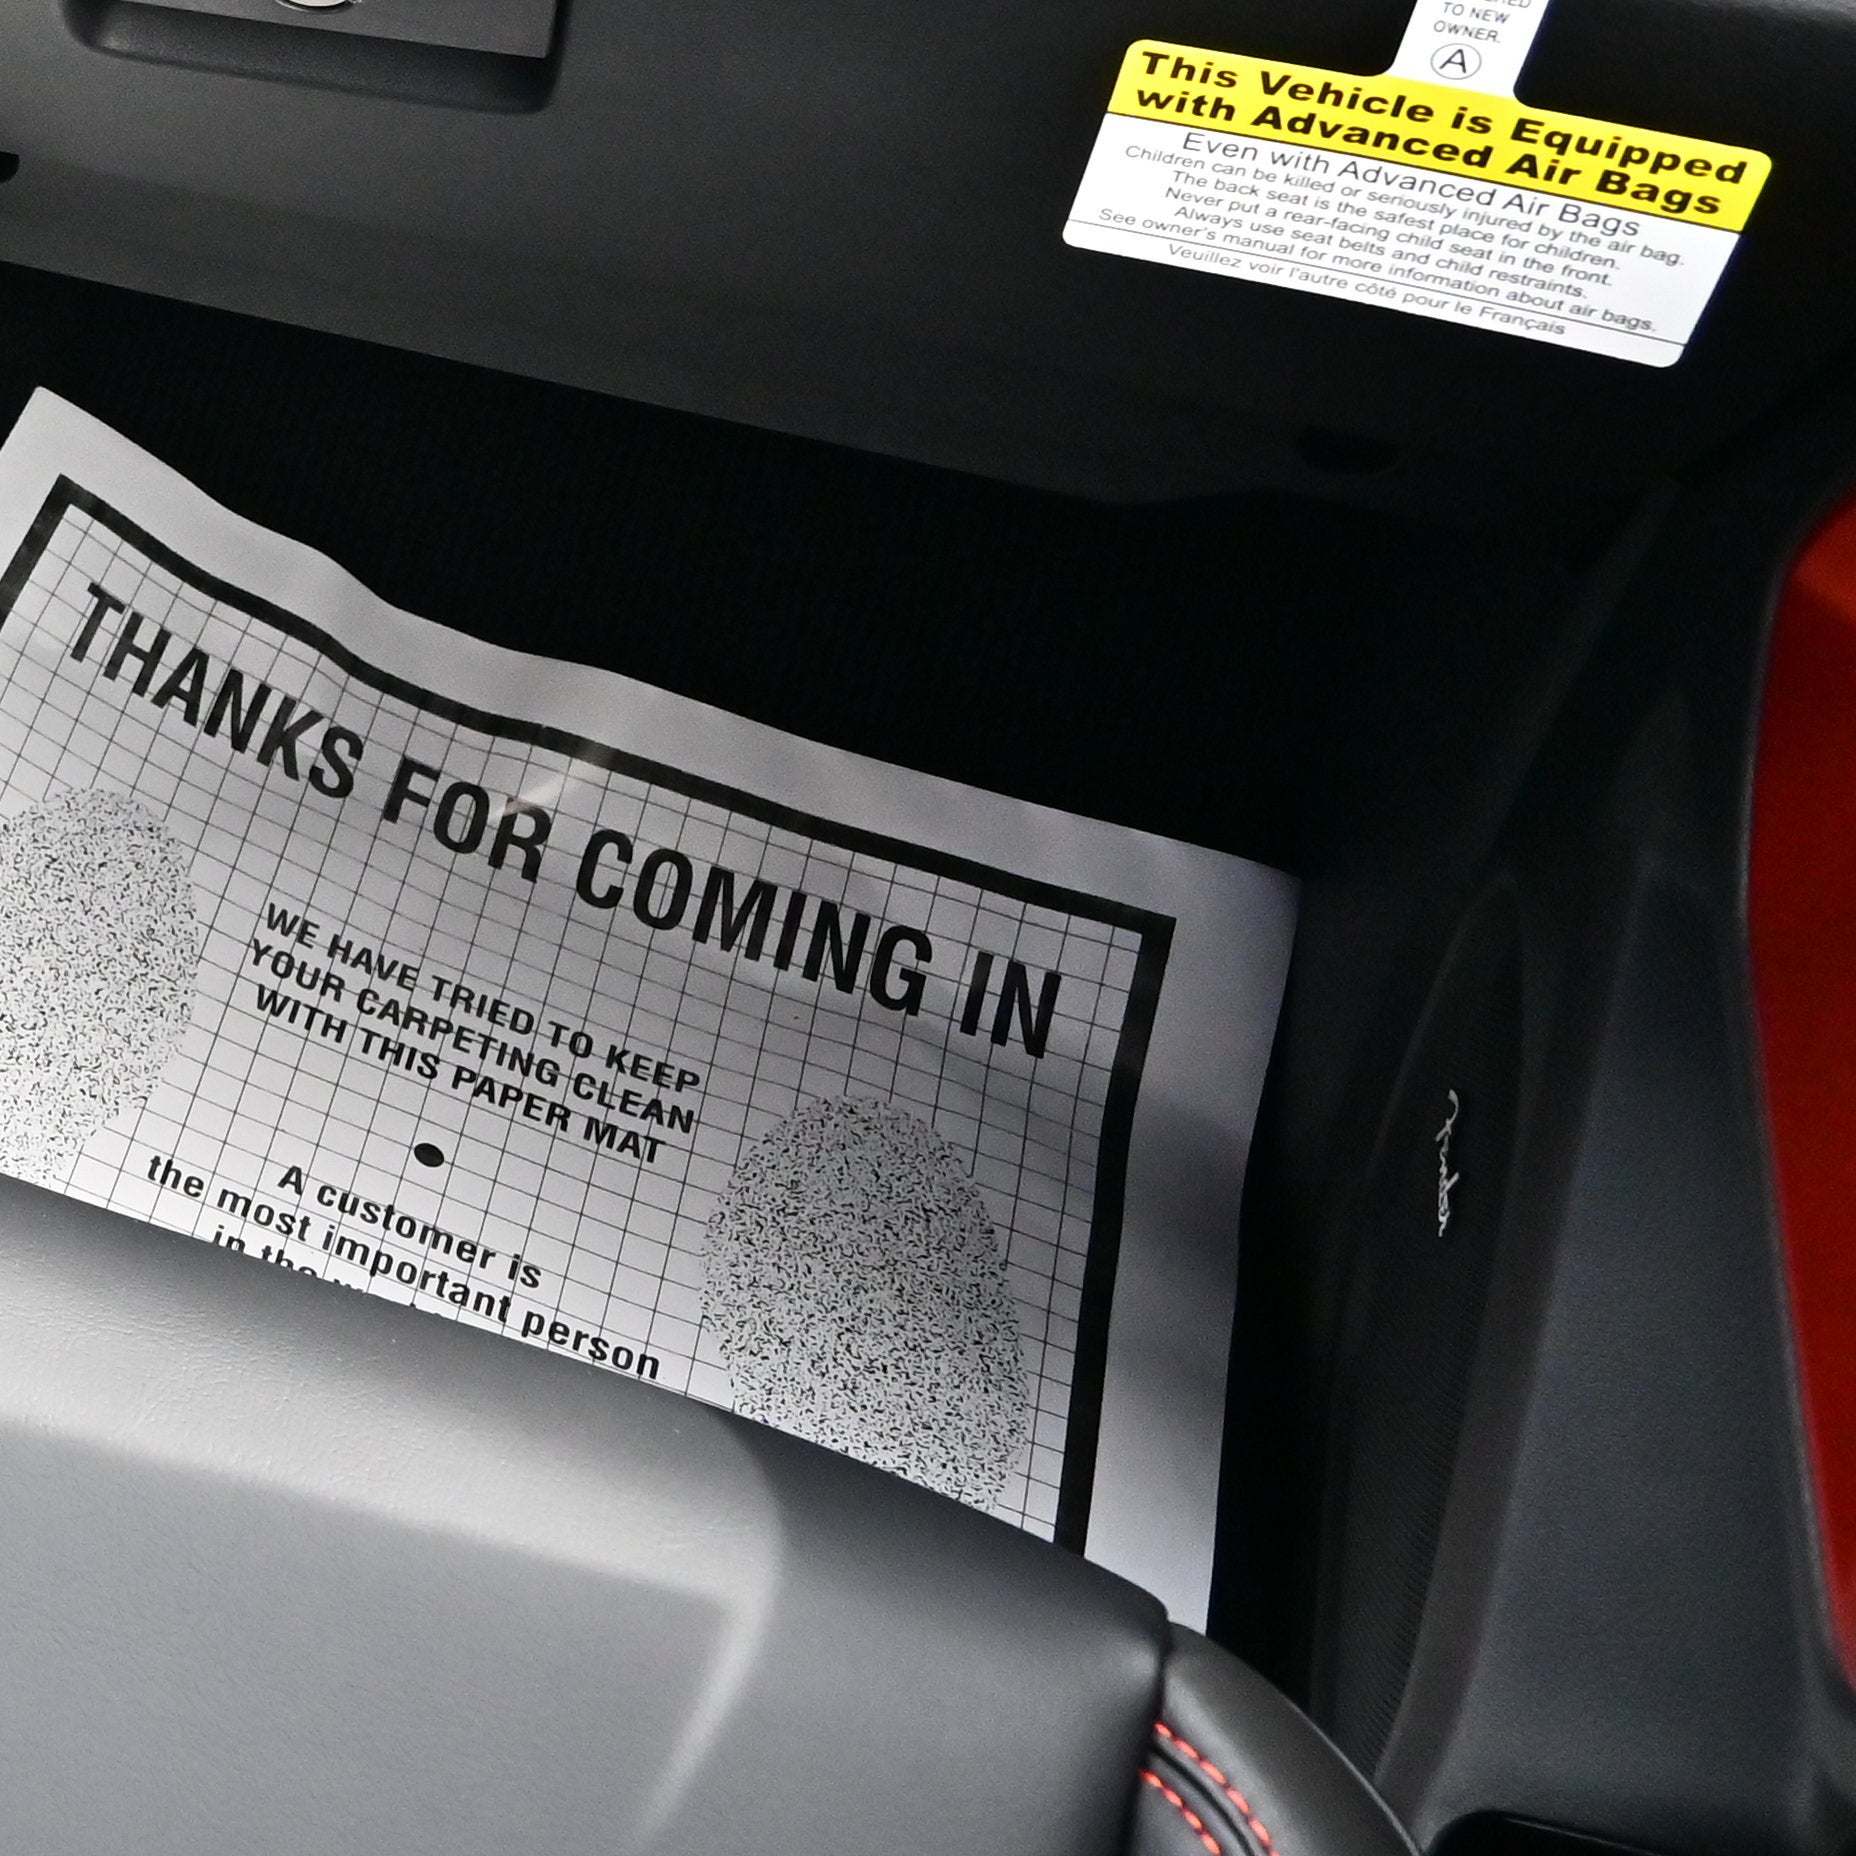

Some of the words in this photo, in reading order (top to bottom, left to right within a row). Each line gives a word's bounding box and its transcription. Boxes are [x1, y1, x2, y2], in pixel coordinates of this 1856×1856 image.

[1434, 20, 1501, 44] OWNER.
[1439, 48, 1467, 74] A
[1443, 2, 1465, 17] TO
[1470, 8, 1511, 24] NEW
[1137, 89, 1236, 122] with
[1250, 105, 1493, 169] Advanced
[1505, 152, 1583, 185] Air
[1596, 169, 1723, 215] Bags
[1142, 51, 1238, 89] This
[1260, 70, 1435, 124] Vehicle
[1451, 106, 1493, 135] is
[1510, 117, 1748, 185] Equipped
[1124, 145, 1206, 171] Children
[1212, 163, 1247, 177] can
[1252, 165, 1278, 183] be
[1283, 172, 1335, 194] killed
[1340, 185, 1362, 198] or
[1366, 189, 1457, 219] seriously
[1463, 208, 1532, 234] injured
[1537, 223, 1563, 241] by
[1569, 229, 1602, 247] the
[1608, 238, 1636, 254] air
[1640, 245, 1685, 267] bag.
[1182, 131, 1258, 161] Even
[1270, 151, 1330, 174] with
[1337, 160, 1497, 207] Advanced
[1502, 192, 1551, 217] Air
[1558, 202, 1641, 238] Bags
[69, 582, 365, 801] THANKS
[381, 756, 554, 885] FOR
[575, 828, 934, 1018] COMING
[960, 950, 1062, 1059] IN
[247, 939, 347, 1003] YOUR
[355, 987, 560, 1088] CARPETING
[572, 1070, 696, 1135] CLEAN
[265, 902, 322, 950] WE
[327, 933, 421, 993] HAVE
[430, 974, 537, 1037] TRIED
[546, 1019, 595, 1059] TO
[605, 1048, 701, 1096] KEEP
[255, 984, 346, 1045] WITH
[359, 1028, 440, 1082] THIS
[452, 1063, 573, 1134] PAPER
[582, 1115, 667, 1165] MAT
[147, 1154, 206, 1198] the
[217, 1186, 311, 1243] most
[322, 1224, 512, 1324] important
[521, 1309, 661, 1381] person
[278, 1165, 305, 1196] A
[316, 1183, 496, 1270] customer
[511, 1252, 542, 1290] is
